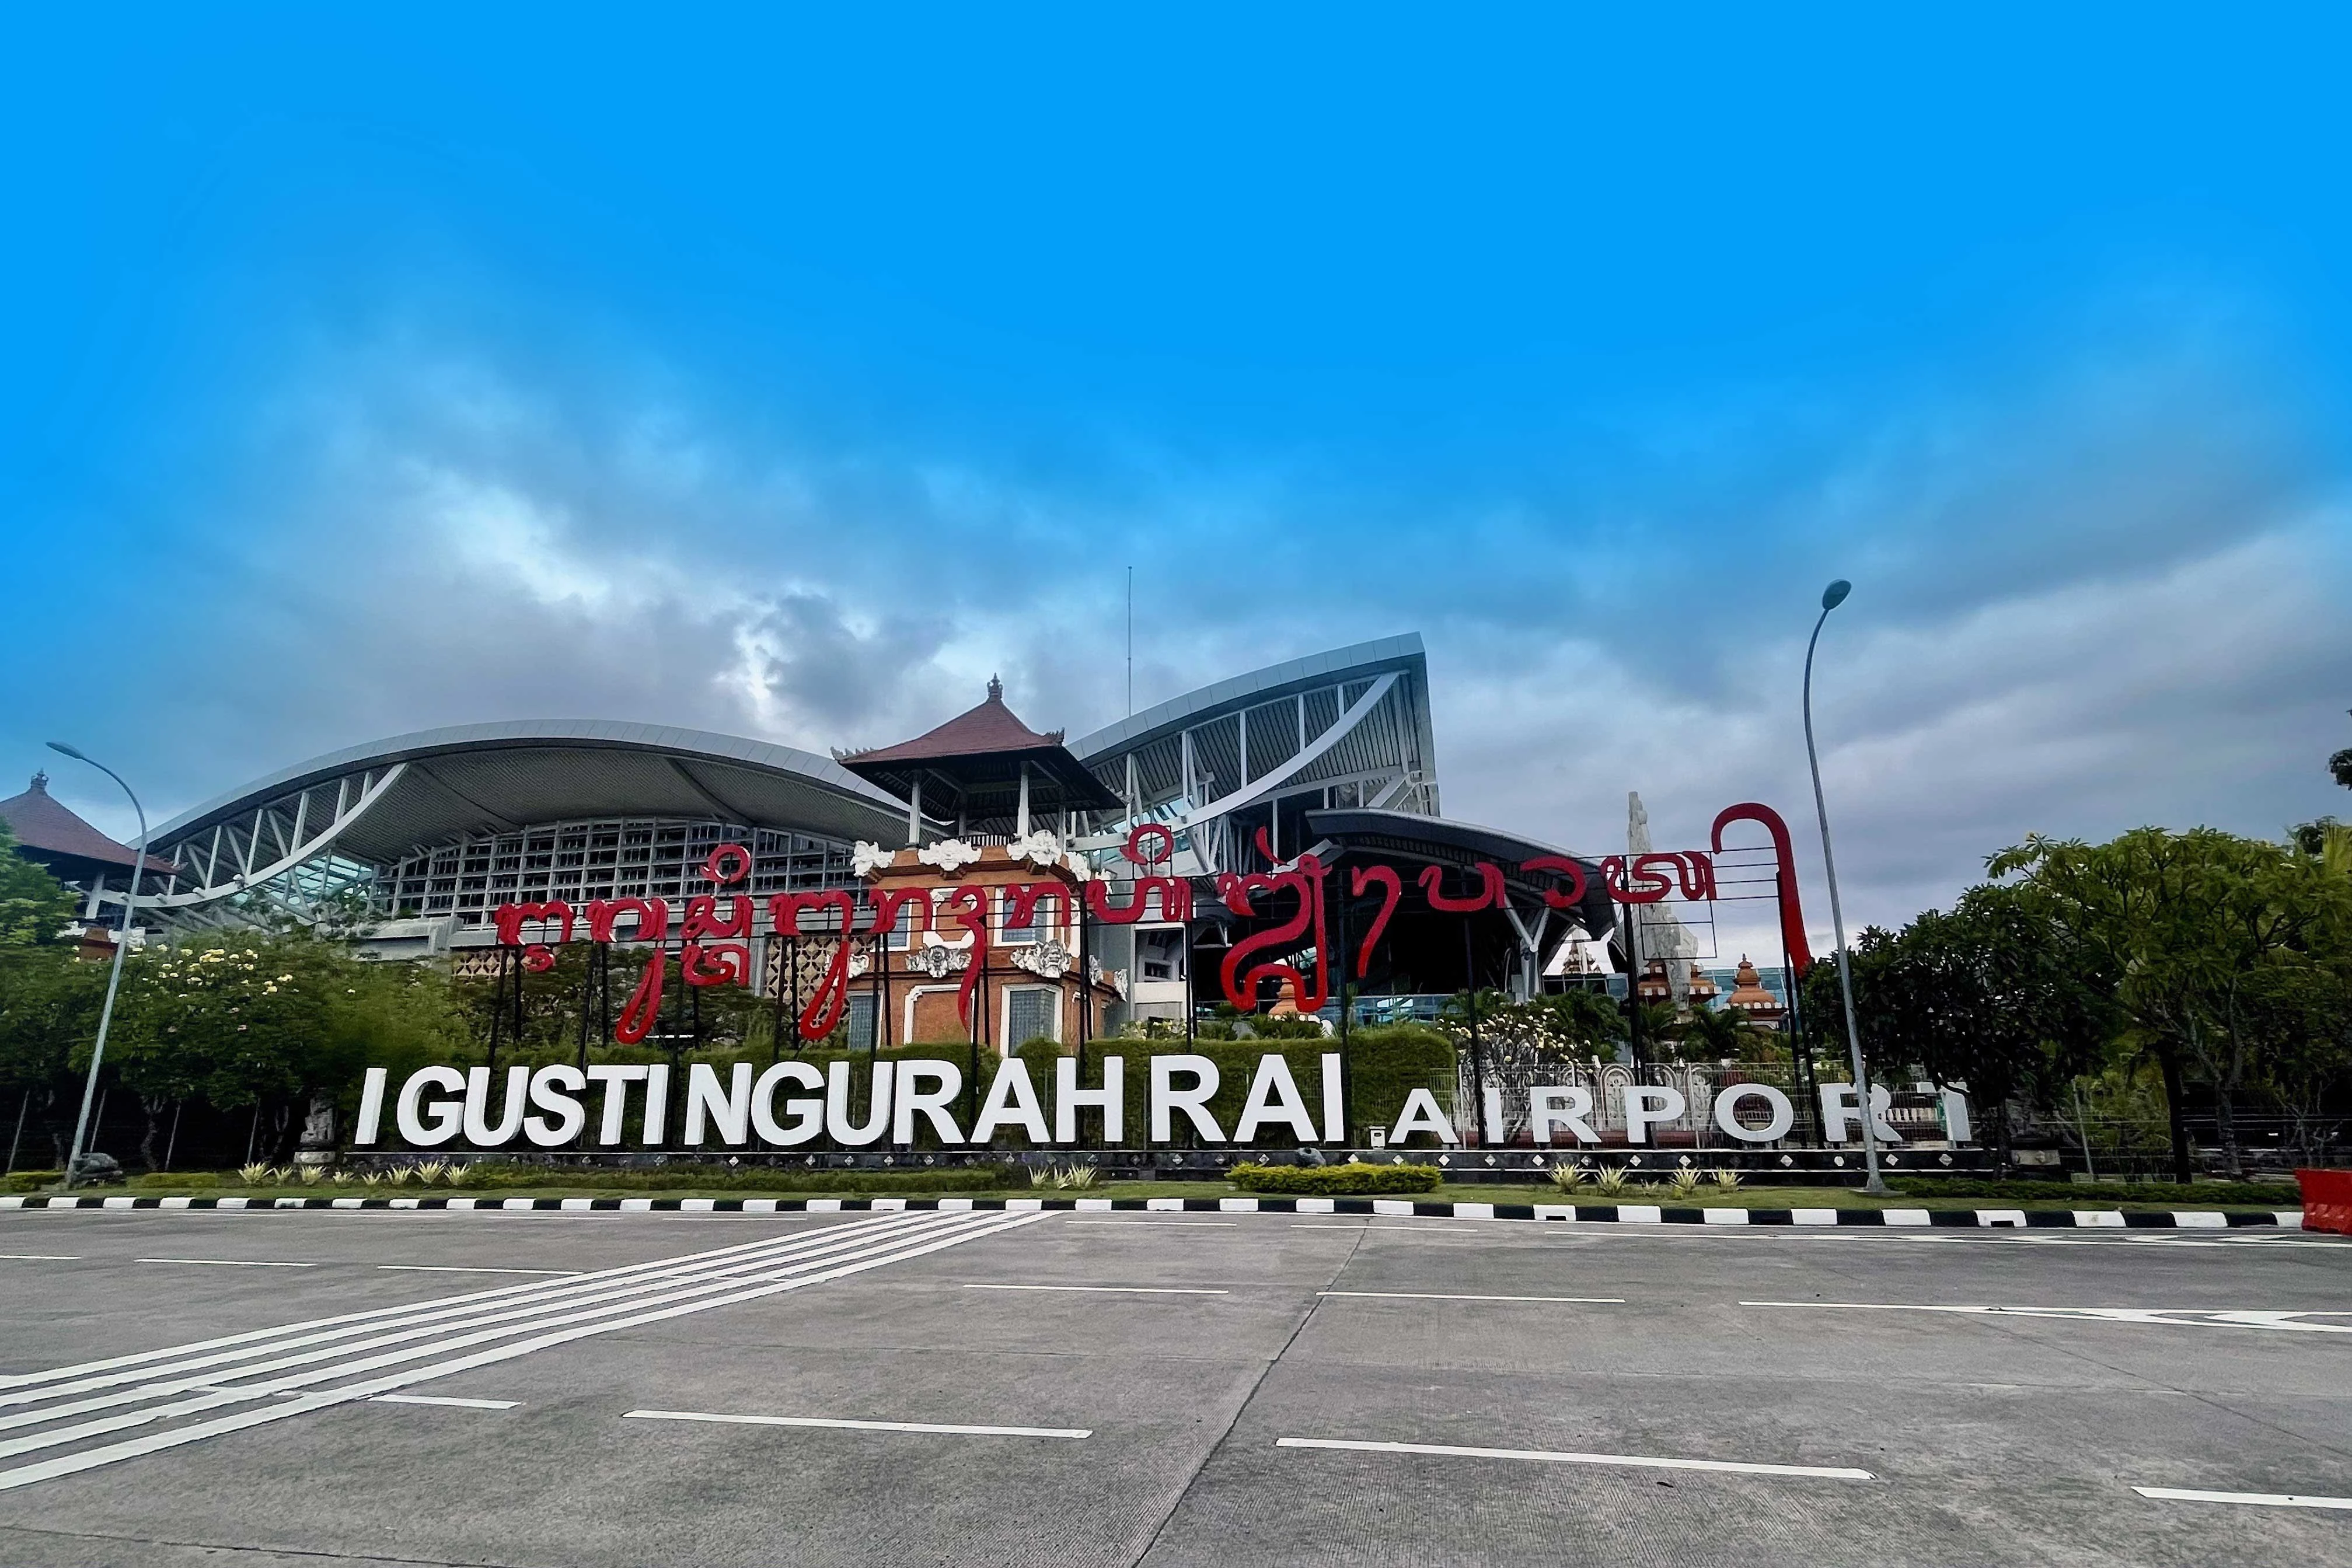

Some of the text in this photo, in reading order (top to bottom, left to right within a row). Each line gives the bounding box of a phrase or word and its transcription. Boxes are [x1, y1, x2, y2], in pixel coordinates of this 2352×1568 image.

[355, 1053, 1971, 1146] I GUSTI NGURAH RAI AIRPORT
